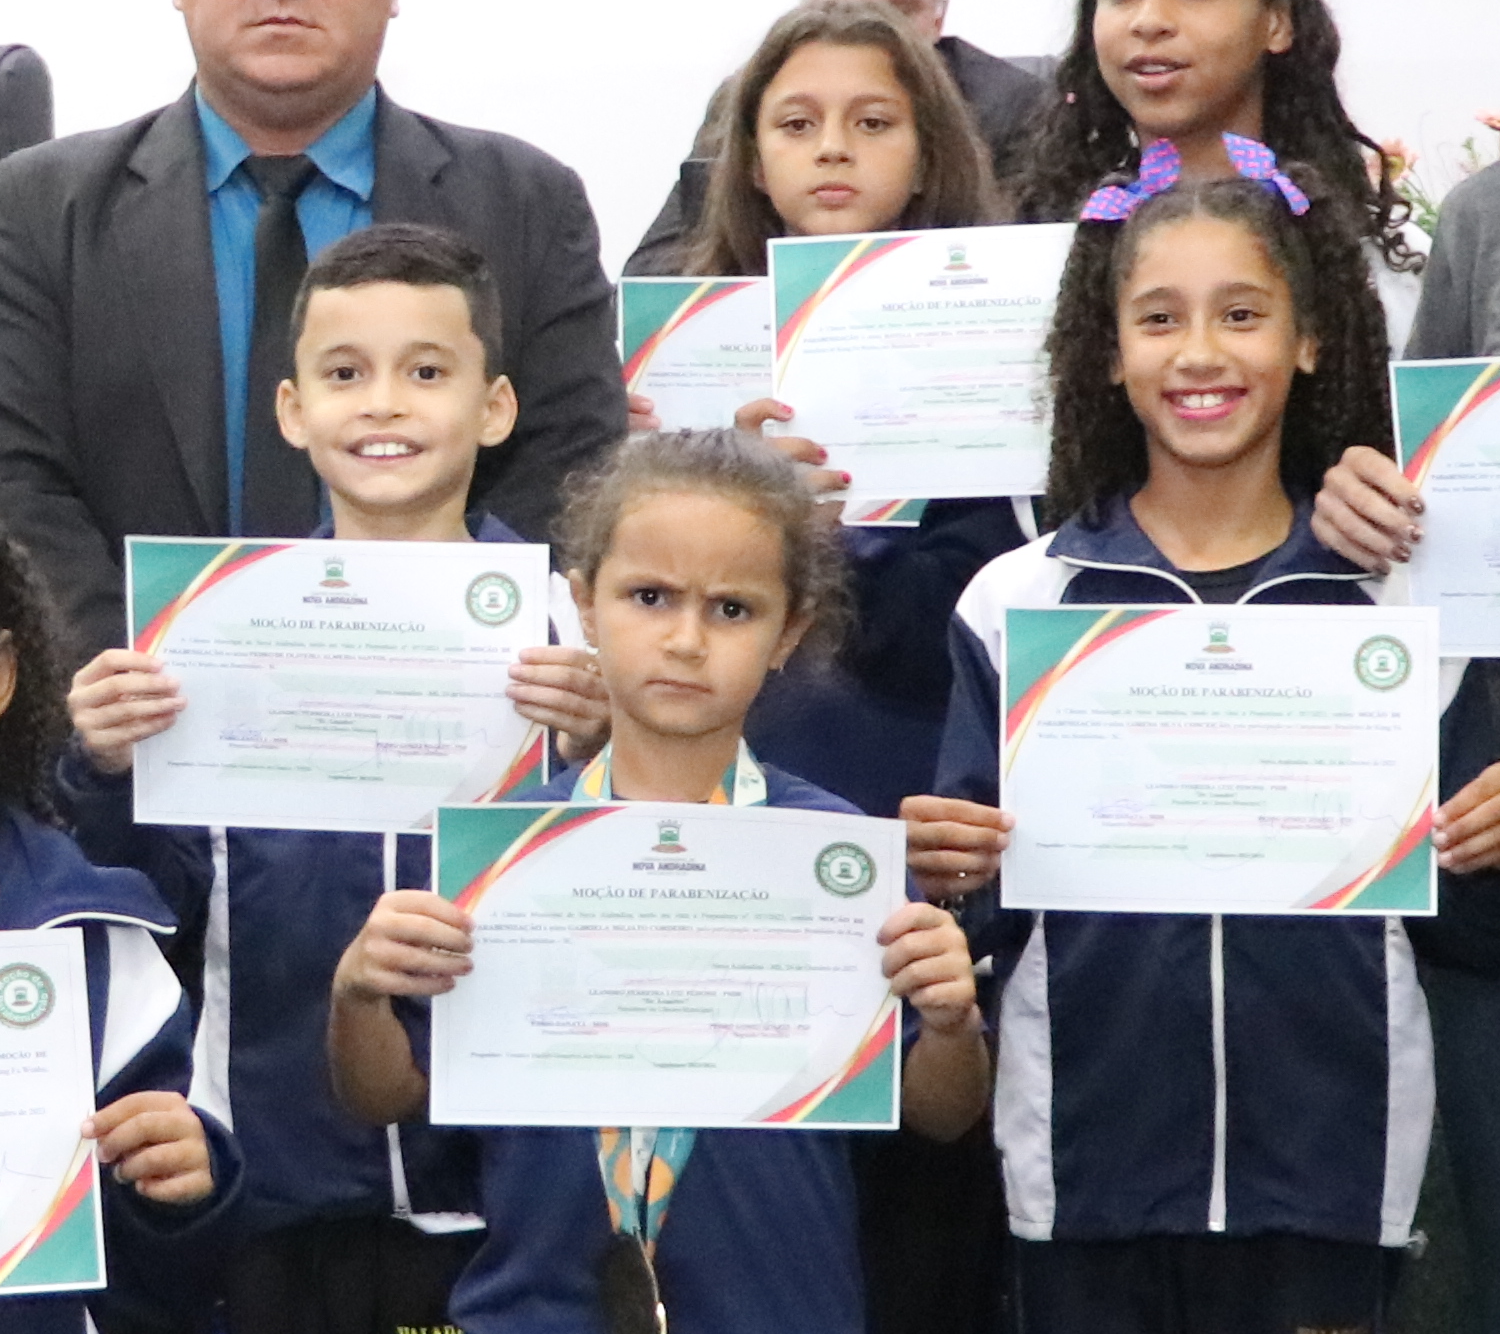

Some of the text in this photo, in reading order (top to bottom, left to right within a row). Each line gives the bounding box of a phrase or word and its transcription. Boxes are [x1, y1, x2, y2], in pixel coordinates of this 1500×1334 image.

[881, 295, 1042, 313] MOÇÃO DE PARABENIZAÇÃO
[250, 617, 426, 634] MOÇÃO DE PARABENIZAÇÃO
[1128, 684, 1314, 700] MOÇÃO DE PARABENIZAÇÃO
[572, 885, 771, 902] MOÇÃO DE PARABENIZAÇÃO
